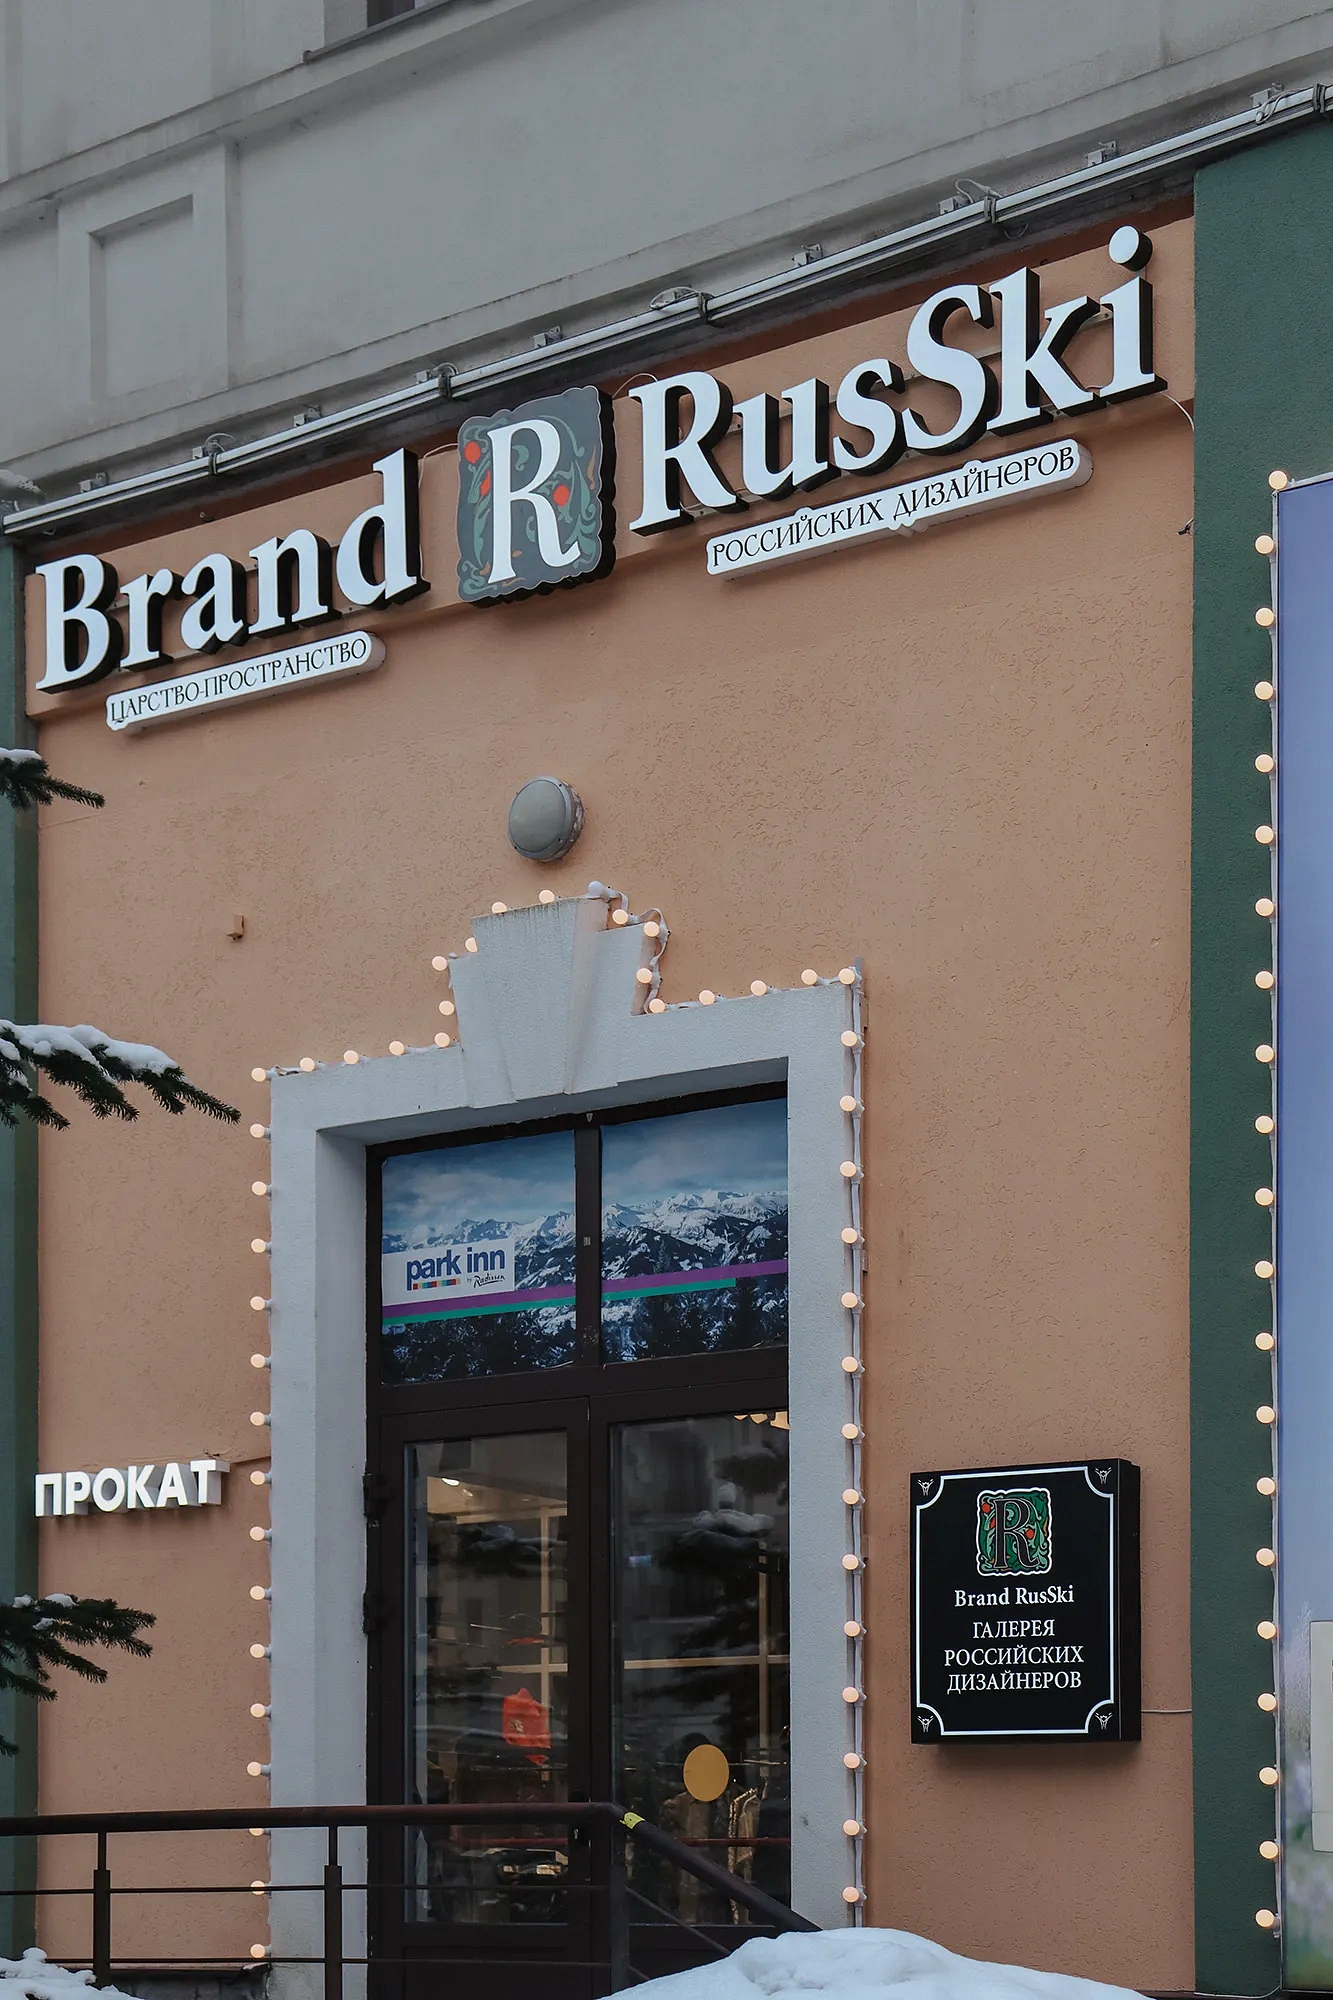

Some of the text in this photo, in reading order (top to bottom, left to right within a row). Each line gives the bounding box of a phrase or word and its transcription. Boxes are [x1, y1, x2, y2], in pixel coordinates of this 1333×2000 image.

[35, 225, 1156, 692] Brand R RusSki
[712, 445, 1075, 567] РОССИЙСКИХ ДИЗАЙНЕРОВ
[110, 638, 368, 724] ЦАРСТВО-ПРОСТРАНСТВО
[406, 1246, 506, 1291] park inn
[35, 1459, 217, 1517] ПРОКАТ
[992, 1497, 1041, 1569] R
[954, 1584, 1075, 1608] Brand RusSki
[972, 1618, 1055, 1640] ГАЛЕРЕЯ
[944, 1645, 1085, 1667] РОССИЙСКИХ
[947, 1670, 1082, 1695] ДИЗАЙНЕРОВ
